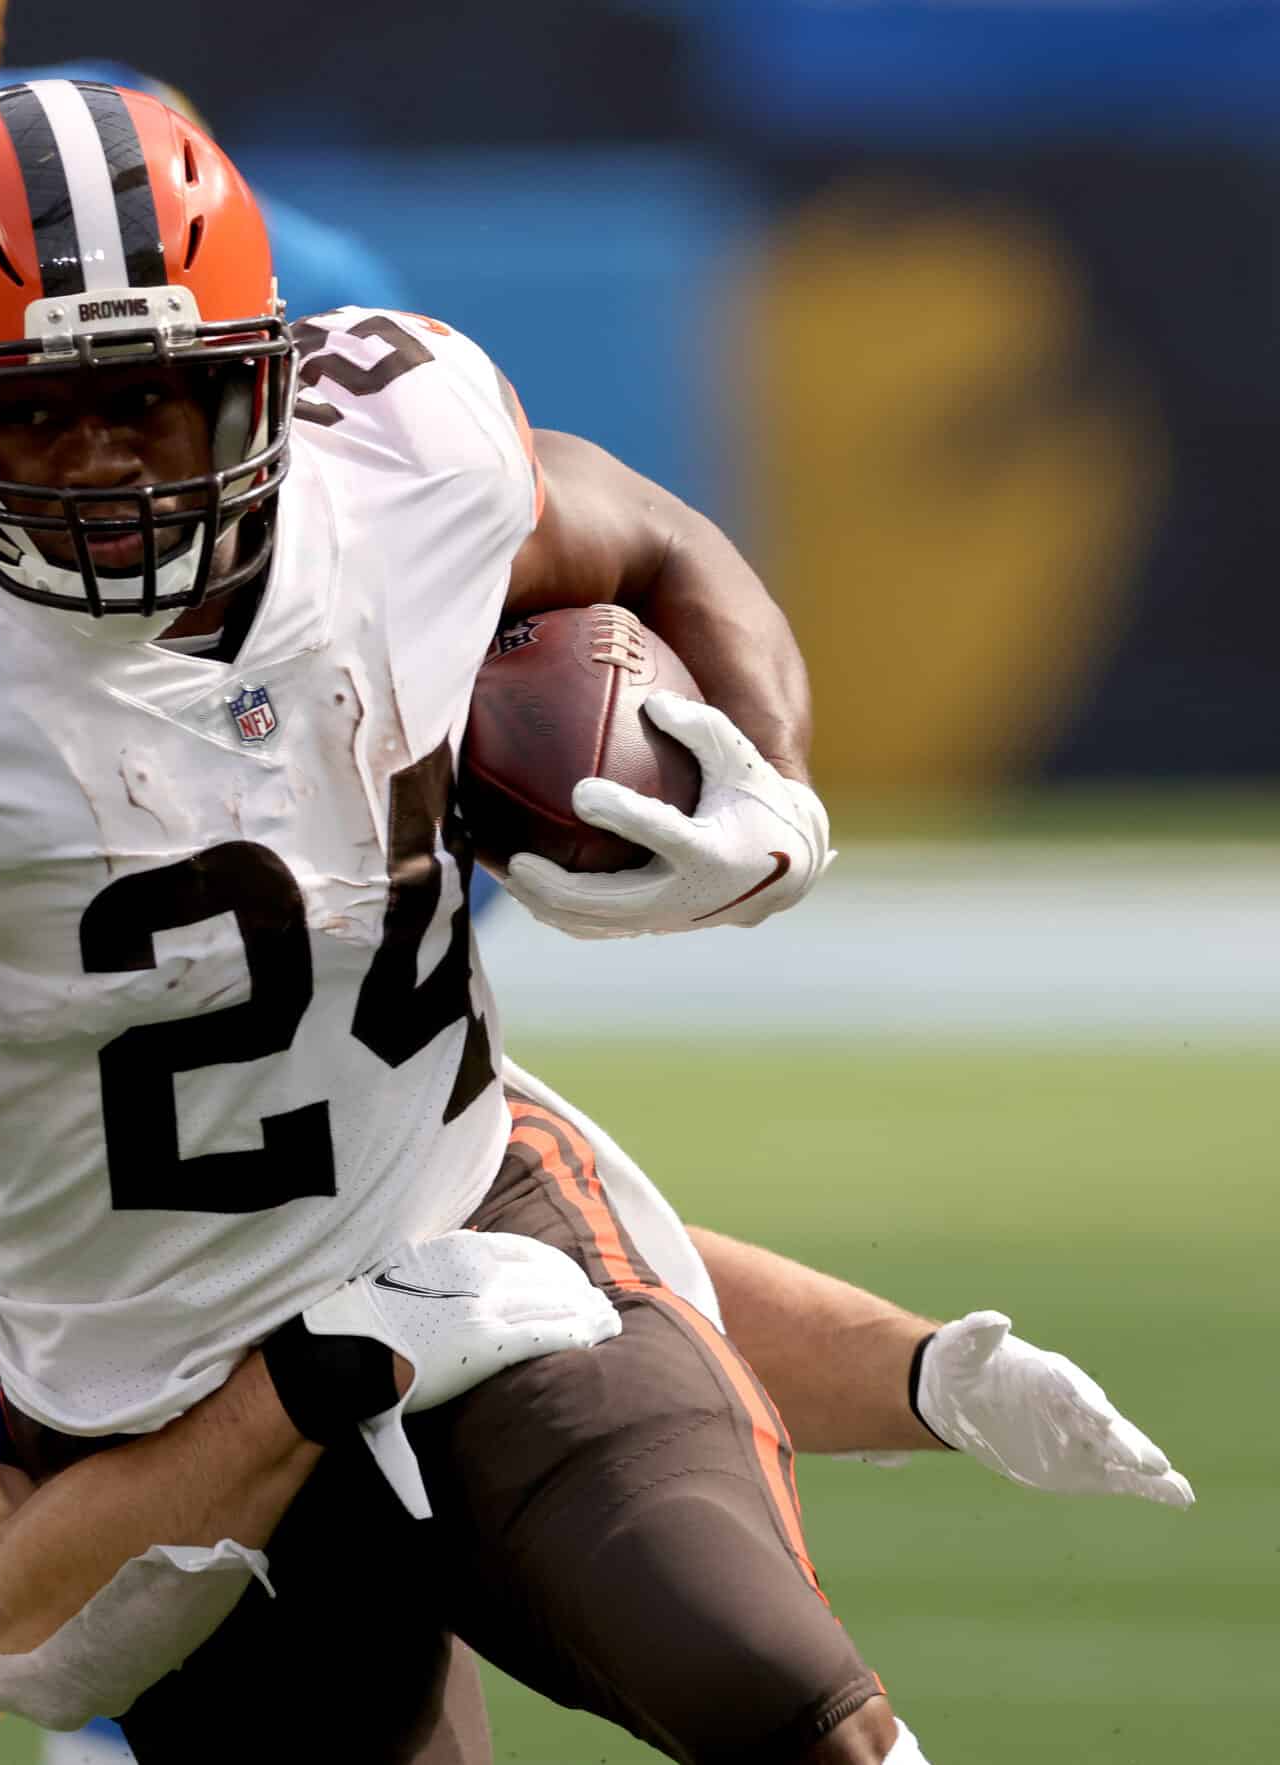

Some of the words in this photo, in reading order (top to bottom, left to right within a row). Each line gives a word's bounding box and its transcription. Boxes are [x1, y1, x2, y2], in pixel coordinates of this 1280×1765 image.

[78, 298, 149, 322] BROWNS
[293, 310, 436, 428] 2
[239, 706, 274, 738] NFL
[79, 738, 498, 1215] 24
